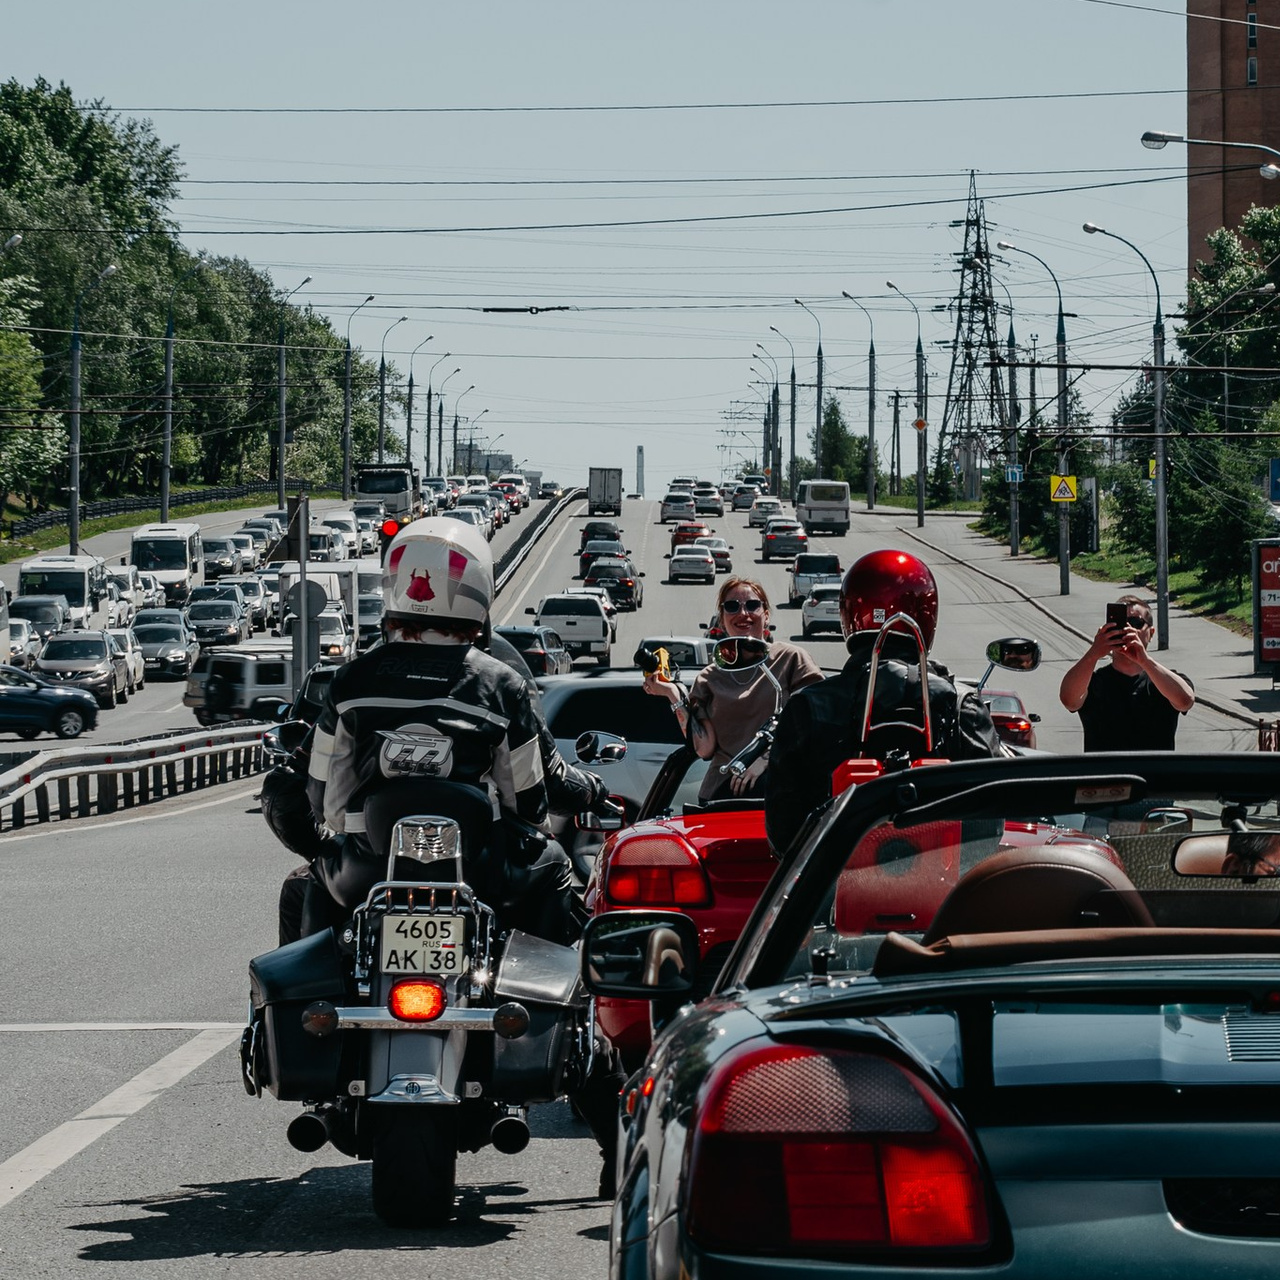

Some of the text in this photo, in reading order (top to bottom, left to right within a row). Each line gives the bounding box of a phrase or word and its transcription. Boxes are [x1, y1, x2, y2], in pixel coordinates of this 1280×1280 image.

[395, 920, 452, 939] 4605
[422, 940, 441, 948] RUS
[385, 949, 456, 970] АК 38
